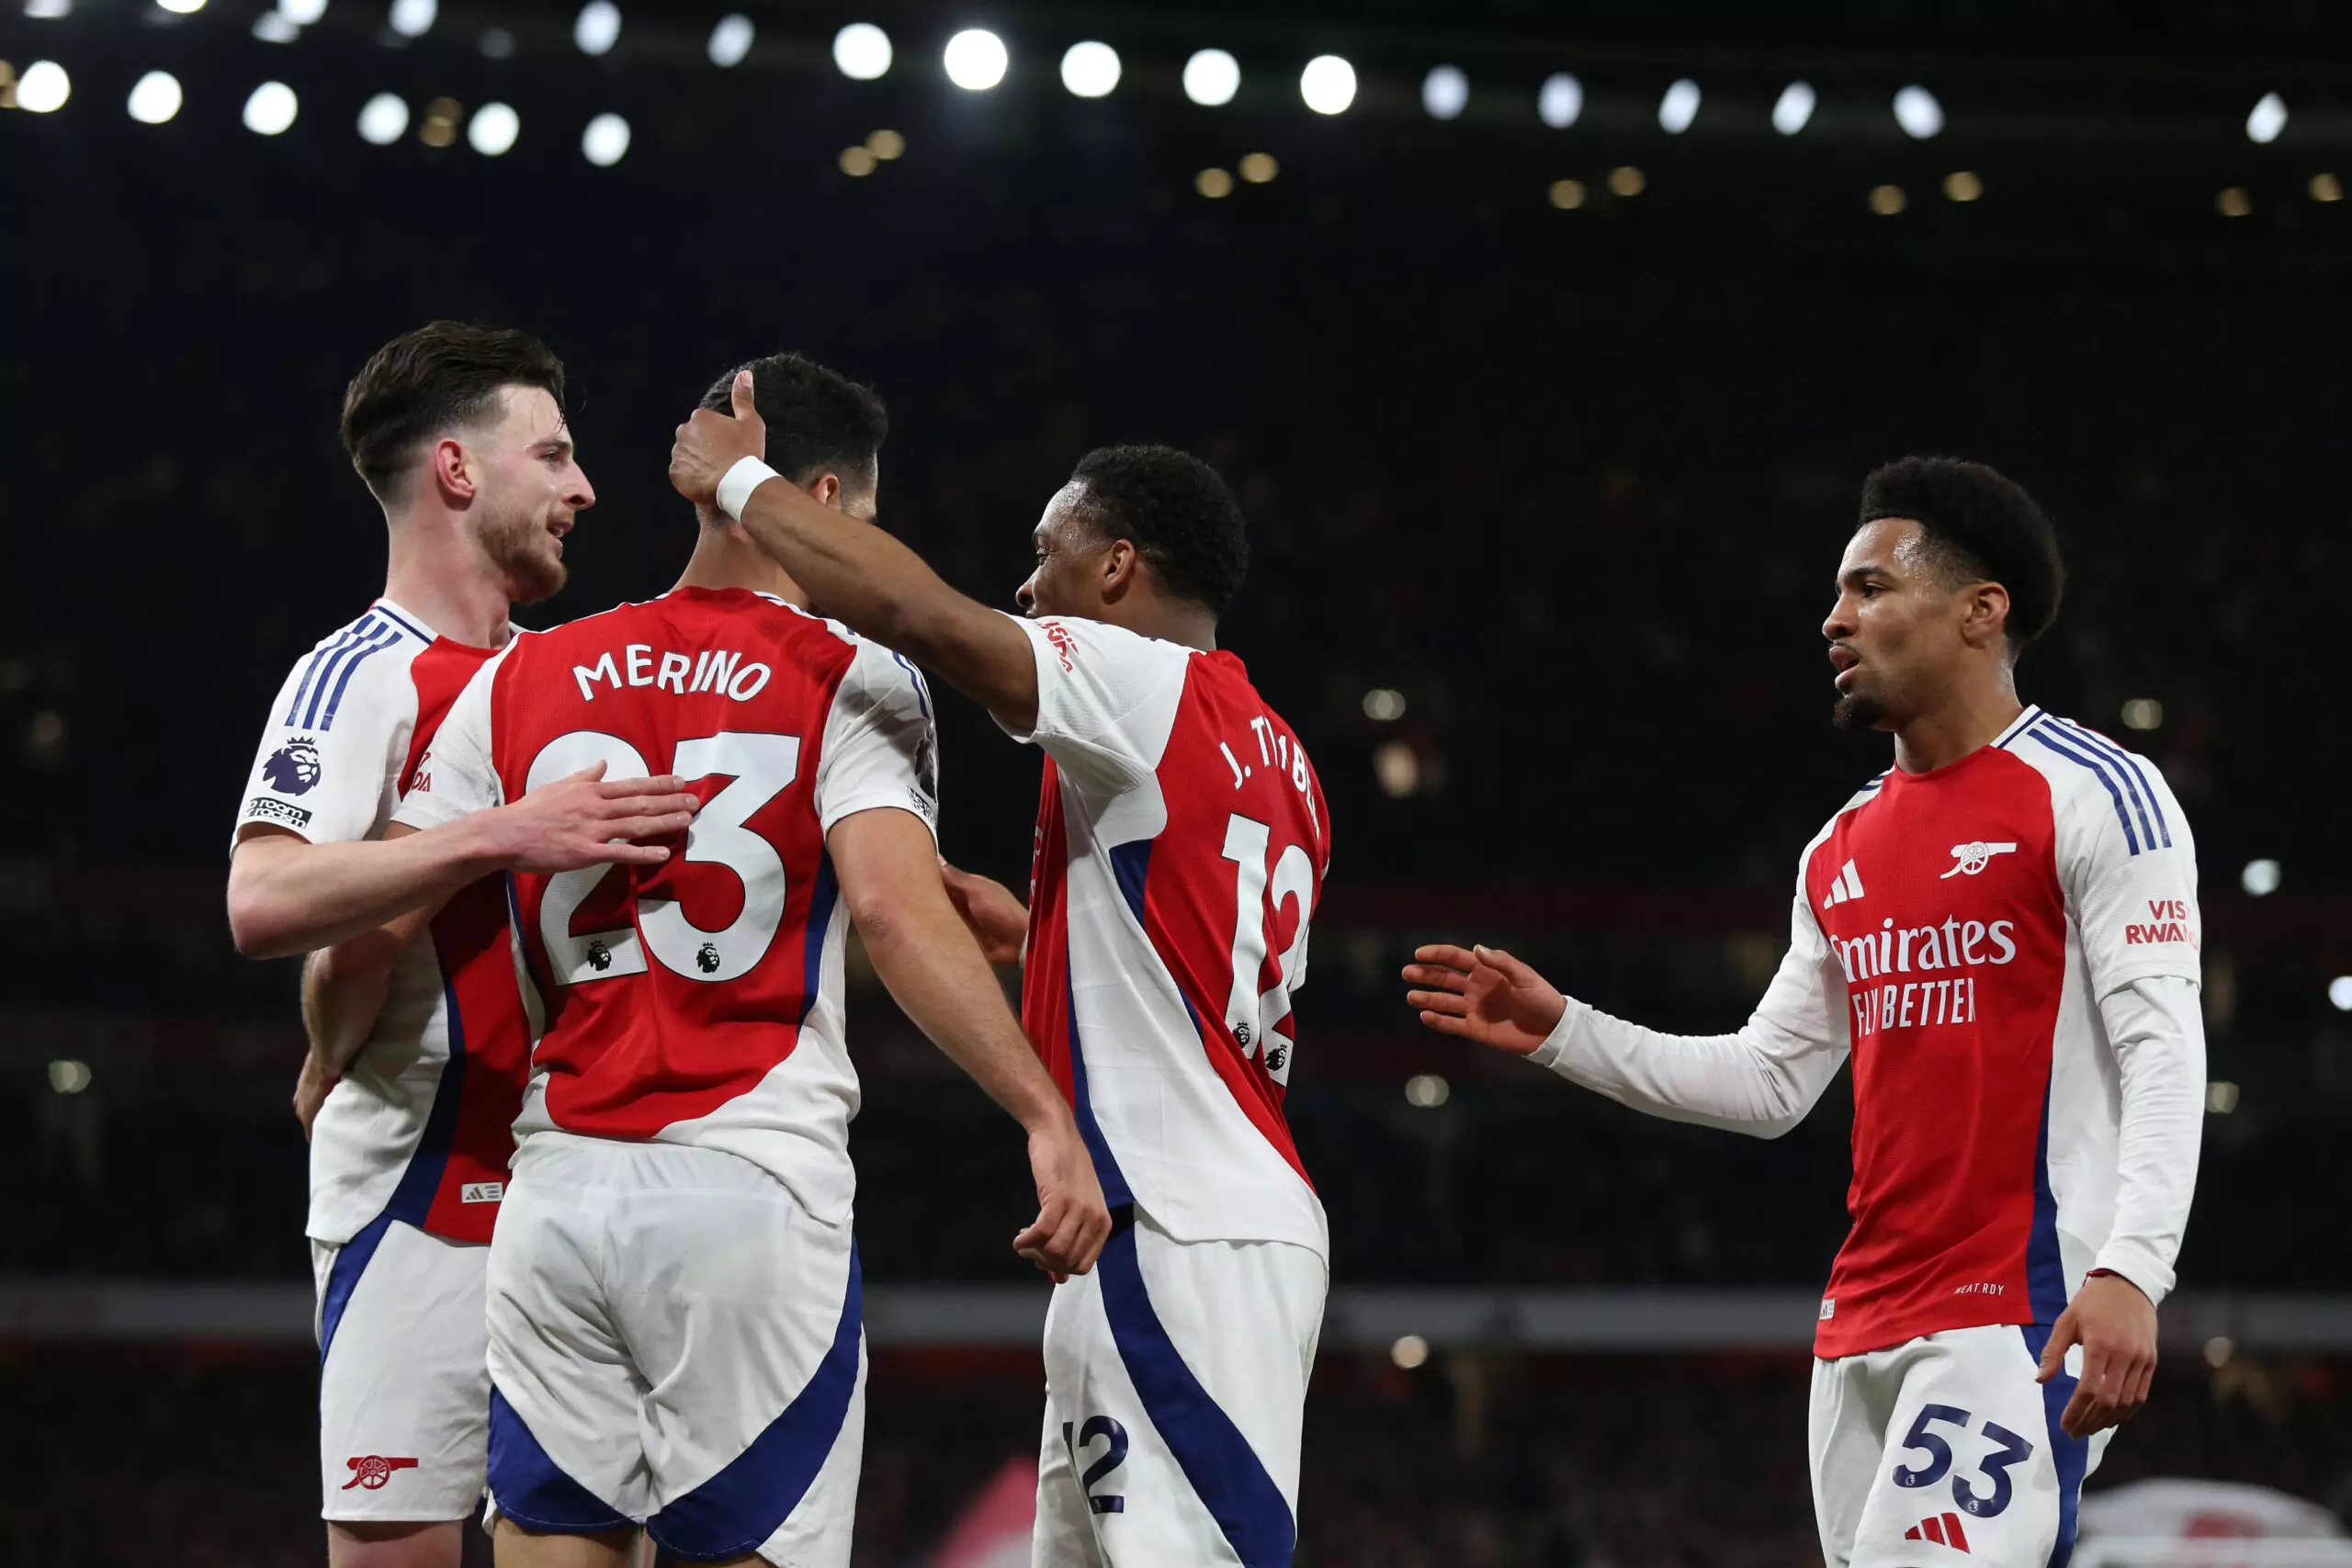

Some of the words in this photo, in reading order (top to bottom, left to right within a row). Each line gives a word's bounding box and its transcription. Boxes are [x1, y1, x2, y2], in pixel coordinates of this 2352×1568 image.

[572, 644, 772, 702] MERINO
[1219, 741, 1251, 790] J.
[259, 799, 303, 819] room
[525, 730, 802, 987] 23
[2125, 922, 2192, 947] RWA
[2148, 899, 2189, 920] VIS
[1220, 812, 1314, 1088] 12
[1892, 1403, 2034, 1518] 53
